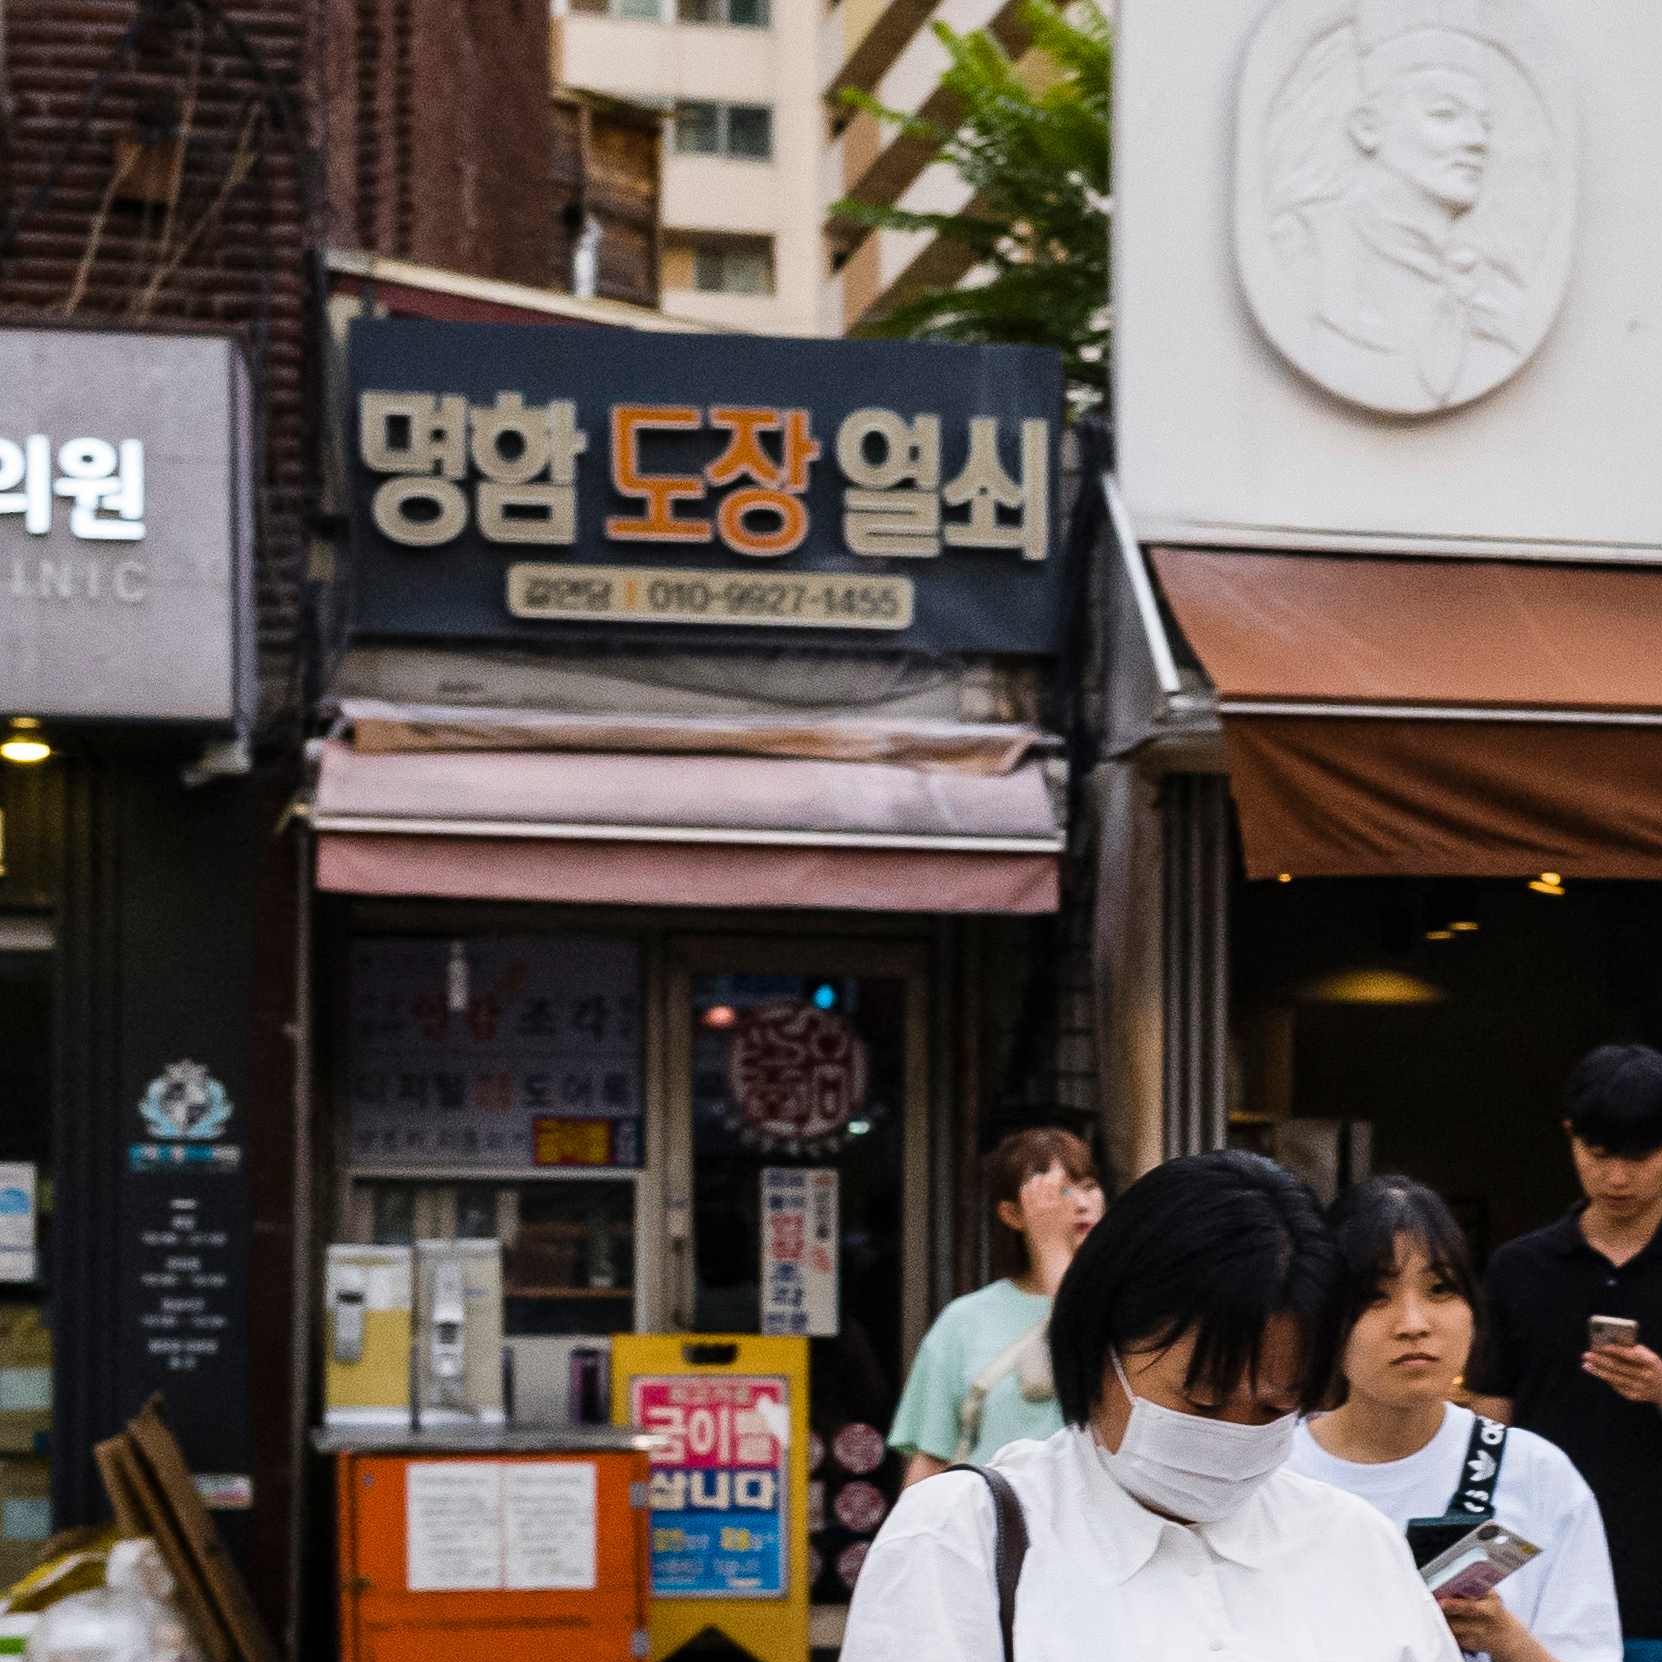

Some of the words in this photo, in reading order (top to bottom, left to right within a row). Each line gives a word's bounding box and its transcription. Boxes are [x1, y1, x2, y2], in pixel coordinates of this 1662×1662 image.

[0, 433, 146, 540] 의원
[358, 390, 588, 547] 명함
[604, 402, 823, 557] 도장
[834, 407, 1049, 560] 열쇠
[649, 1470, 776, 1510] 삽니다
